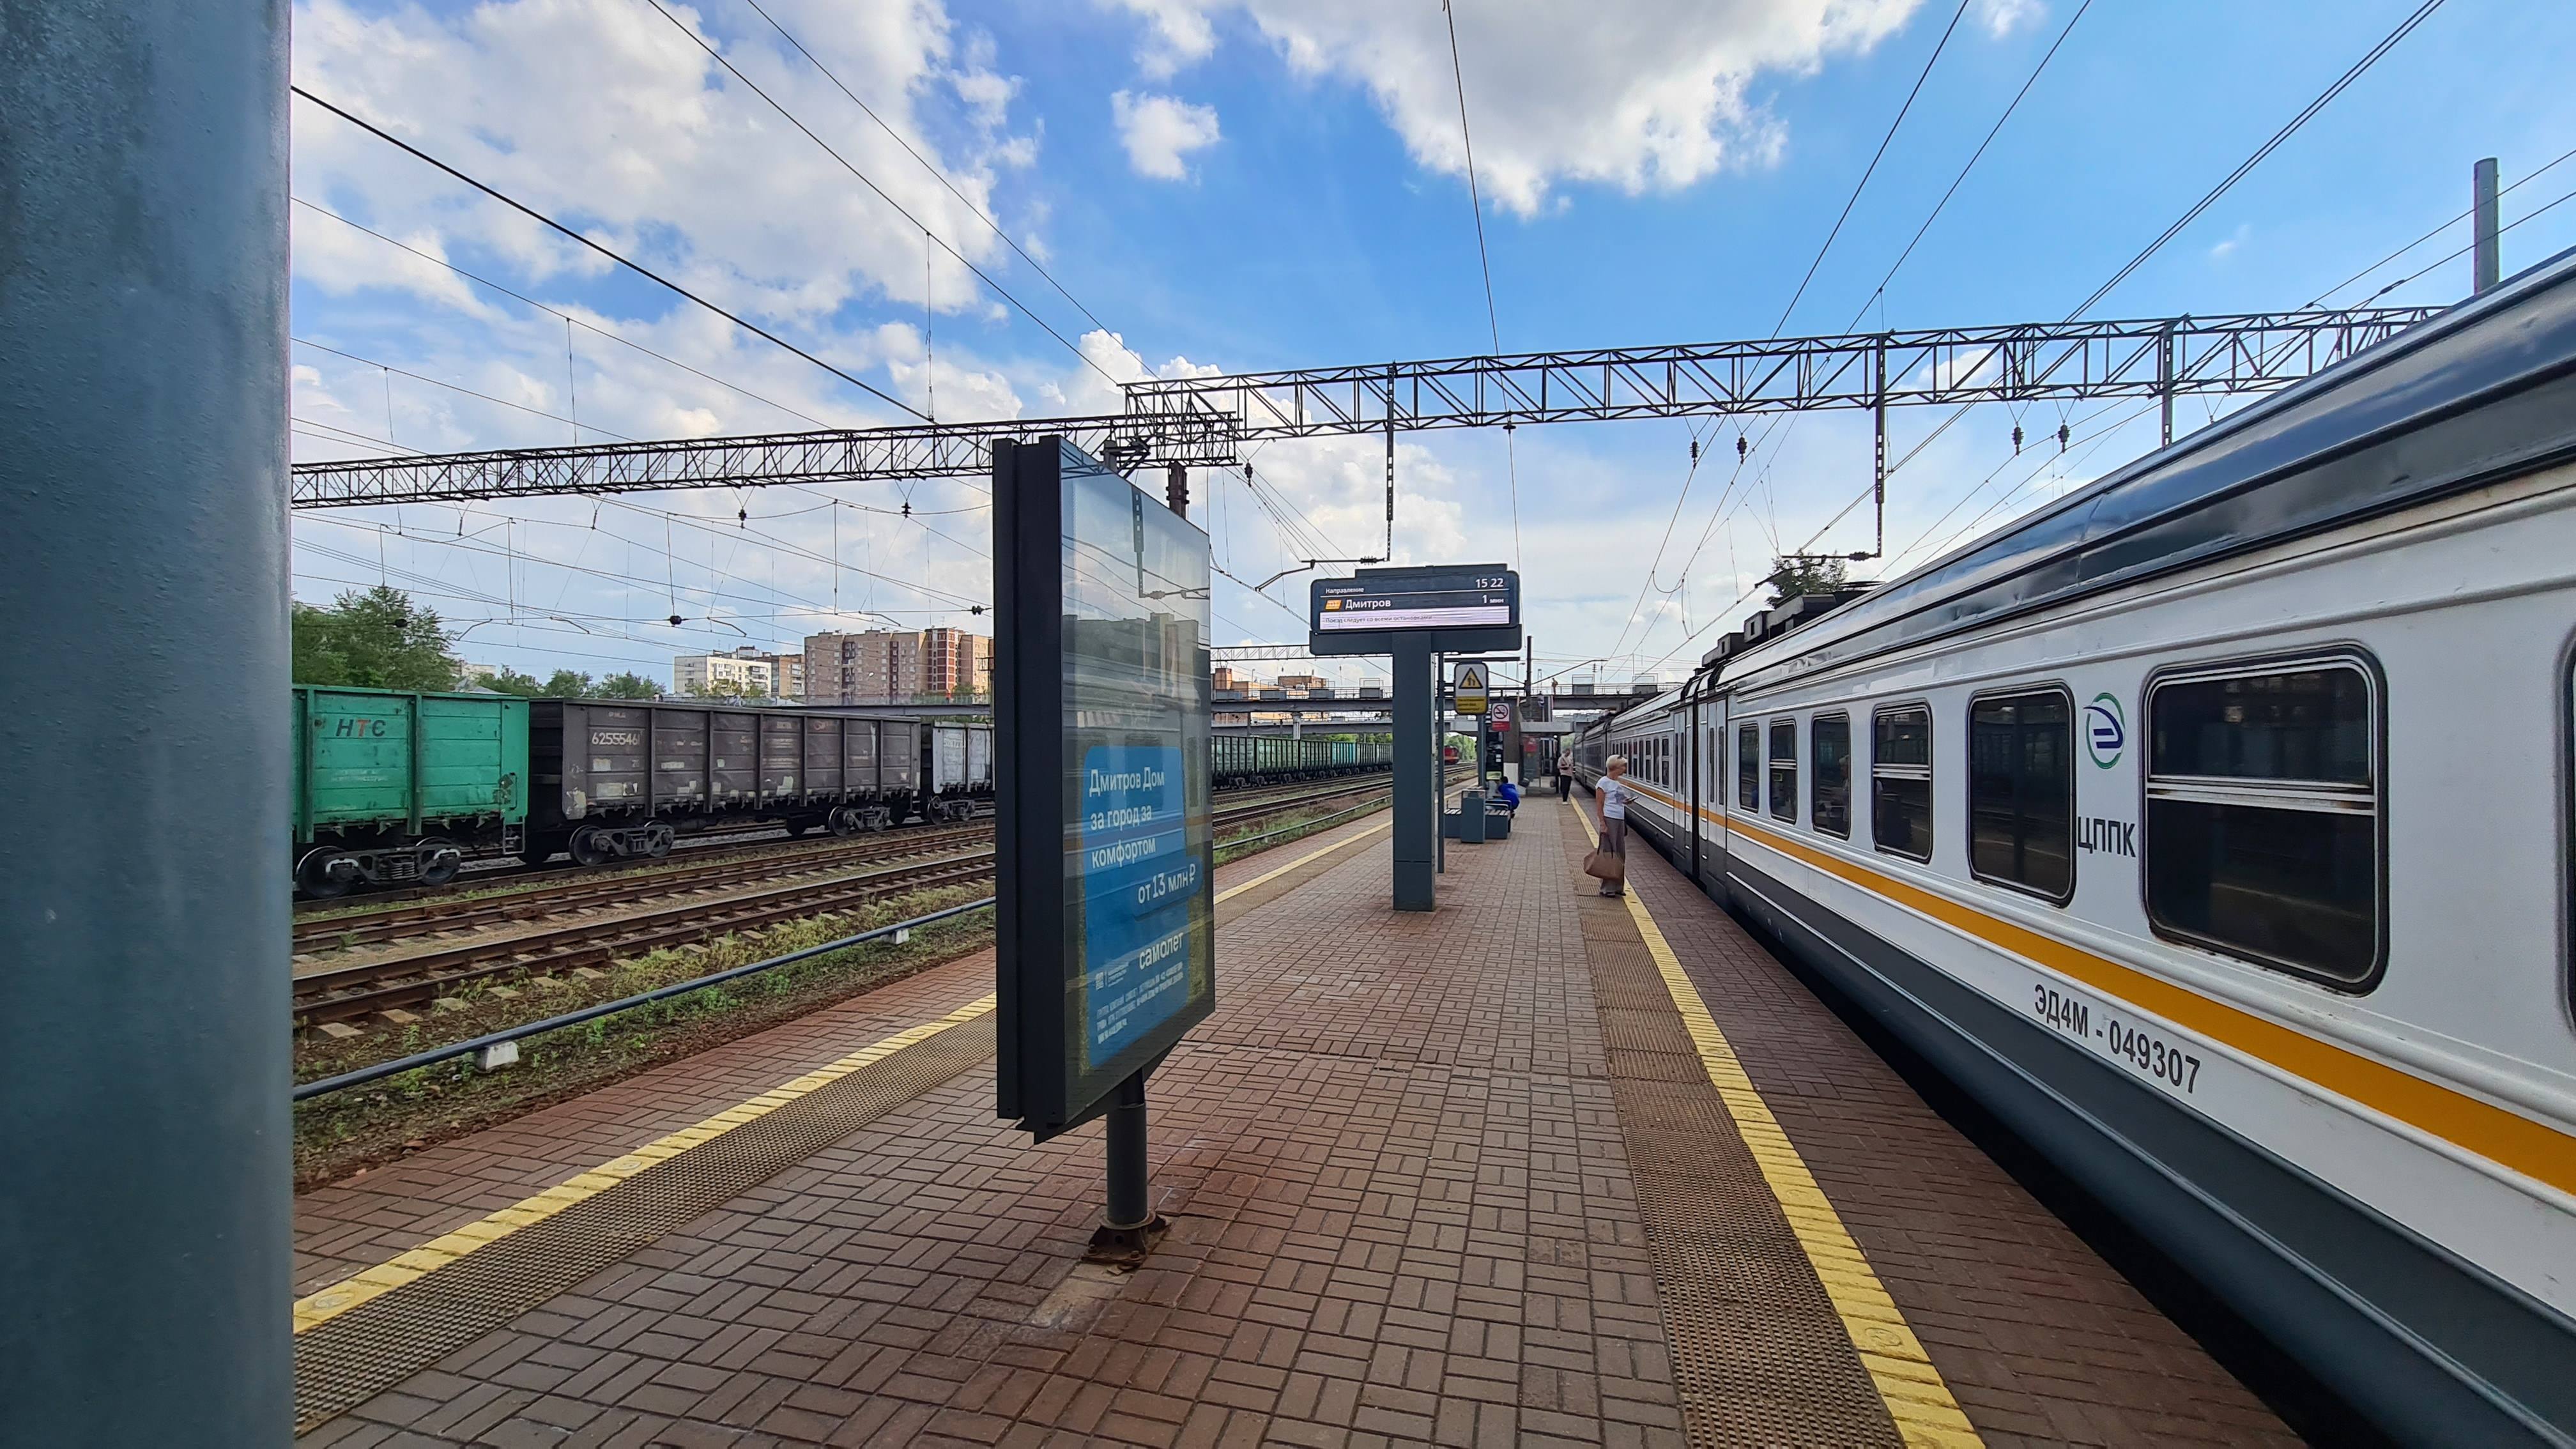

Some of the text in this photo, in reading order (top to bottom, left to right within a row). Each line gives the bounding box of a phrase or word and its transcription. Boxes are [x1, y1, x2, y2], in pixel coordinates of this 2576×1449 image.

[1476, 578, 1504, 588] 15 22
[1346, 599, 1392, 610] Дмитров
[1482, 594, 1487, 604] 1
[335, 719, 386, 737] НТС
[1089, 767, 1165, 797] Дмитров Дом
[1091, 805, 1152, 831] за город за
[2078, 816, 2136, 858] ЦППК
[1092, 838, 1156, 869] комфортом
[1138, 884, 1151, 904] от
[1153, 873, 1166, 898] 13
[1168, 870, 1188, 892] млн
[1139, 932, 1184, 970] самолет
[2035, 985, 2088, 1038] ЭД4М
[2110, 1020, 2200, 1094] 049307
